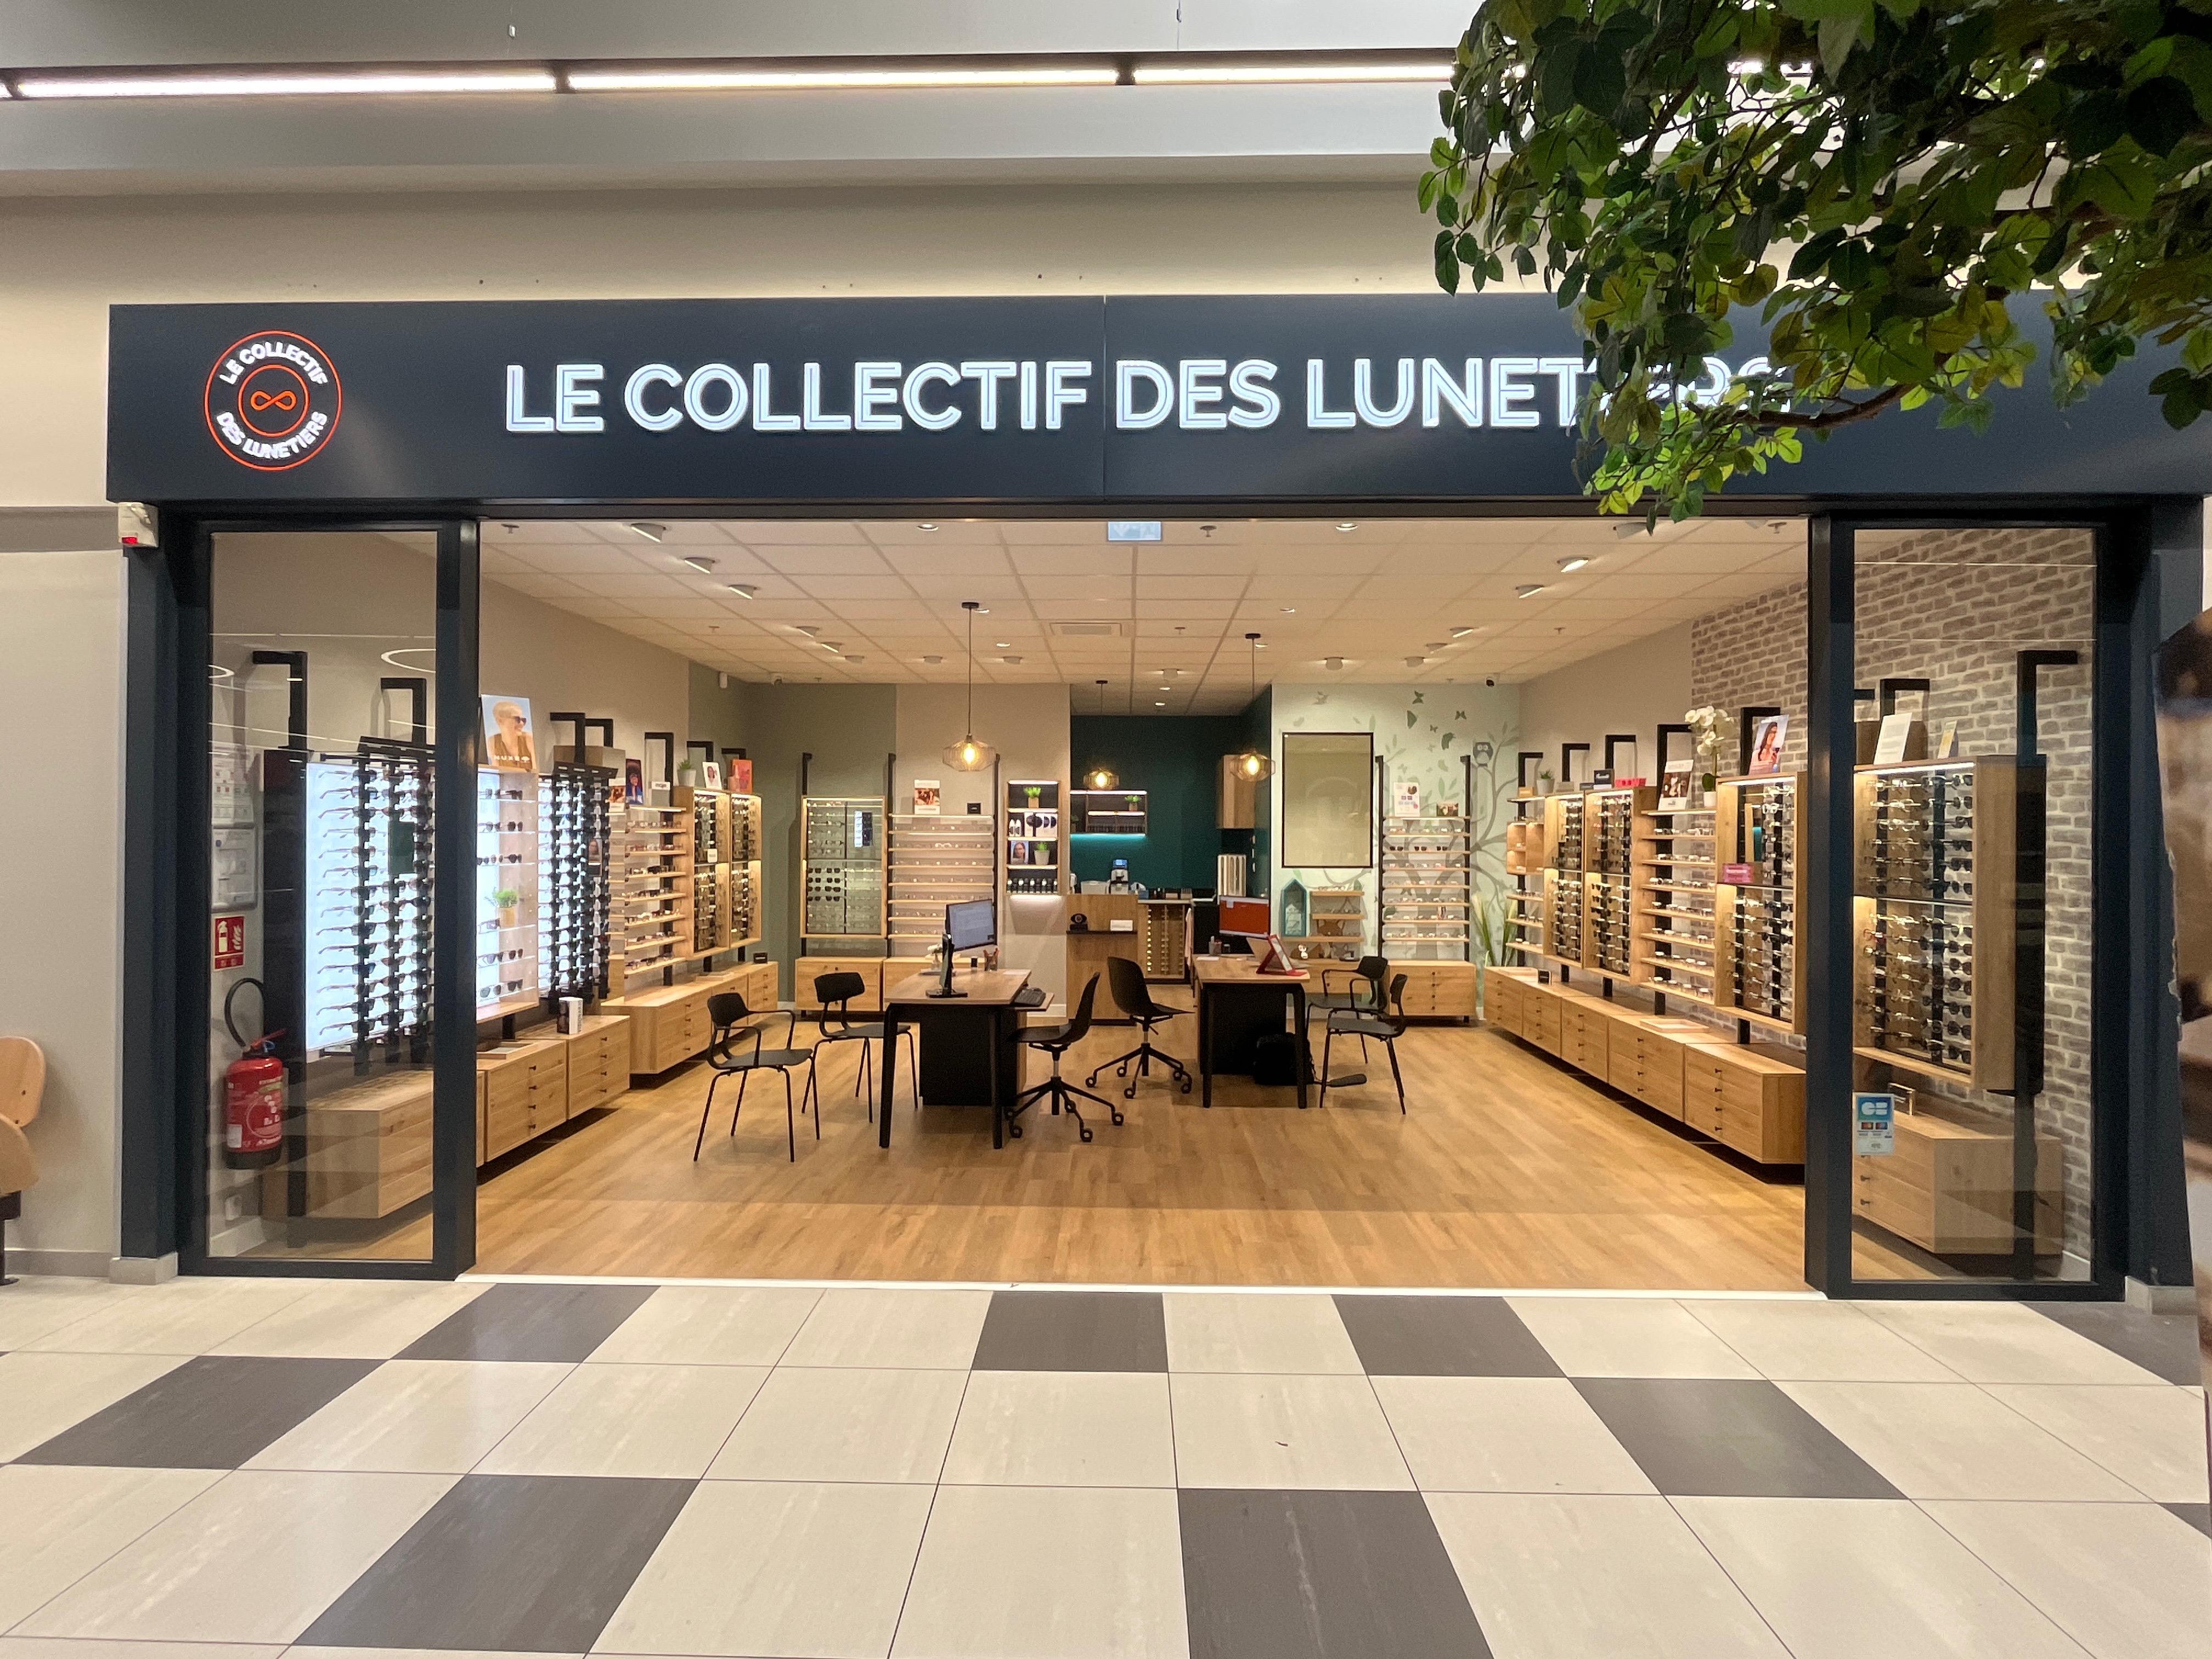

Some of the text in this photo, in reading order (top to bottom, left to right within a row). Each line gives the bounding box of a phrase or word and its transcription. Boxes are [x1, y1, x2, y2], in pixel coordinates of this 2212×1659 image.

[219, 341, 328, 385] LE COLLECTIF
[506, 356, 1790, 432] LE COLLECTIF DES LUNET
[216, 411, 328, 459] DES LUNETIERS
